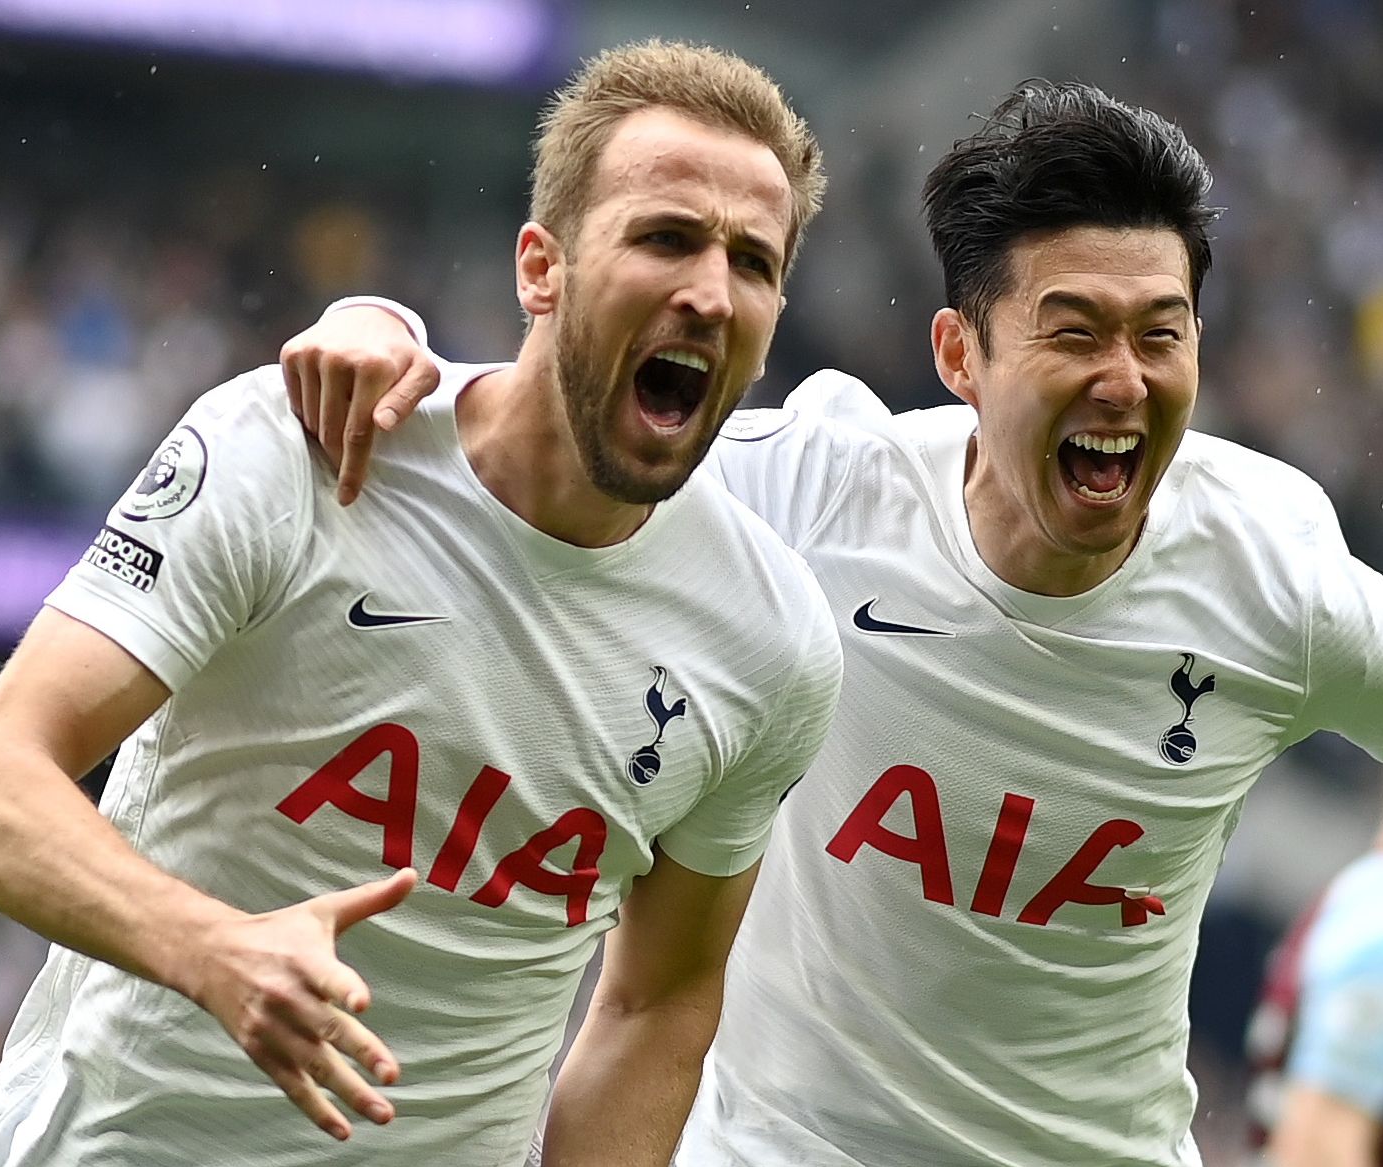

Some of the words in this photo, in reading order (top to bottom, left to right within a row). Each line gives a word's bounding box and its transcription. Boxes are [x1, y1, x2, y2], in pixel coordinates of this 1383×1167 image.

[92, 549, 154, 593] racism
[102, 531, 154, 572] room
[275, 722, 607, 927] AIA
[825, 764, 1166, 928] AIA
